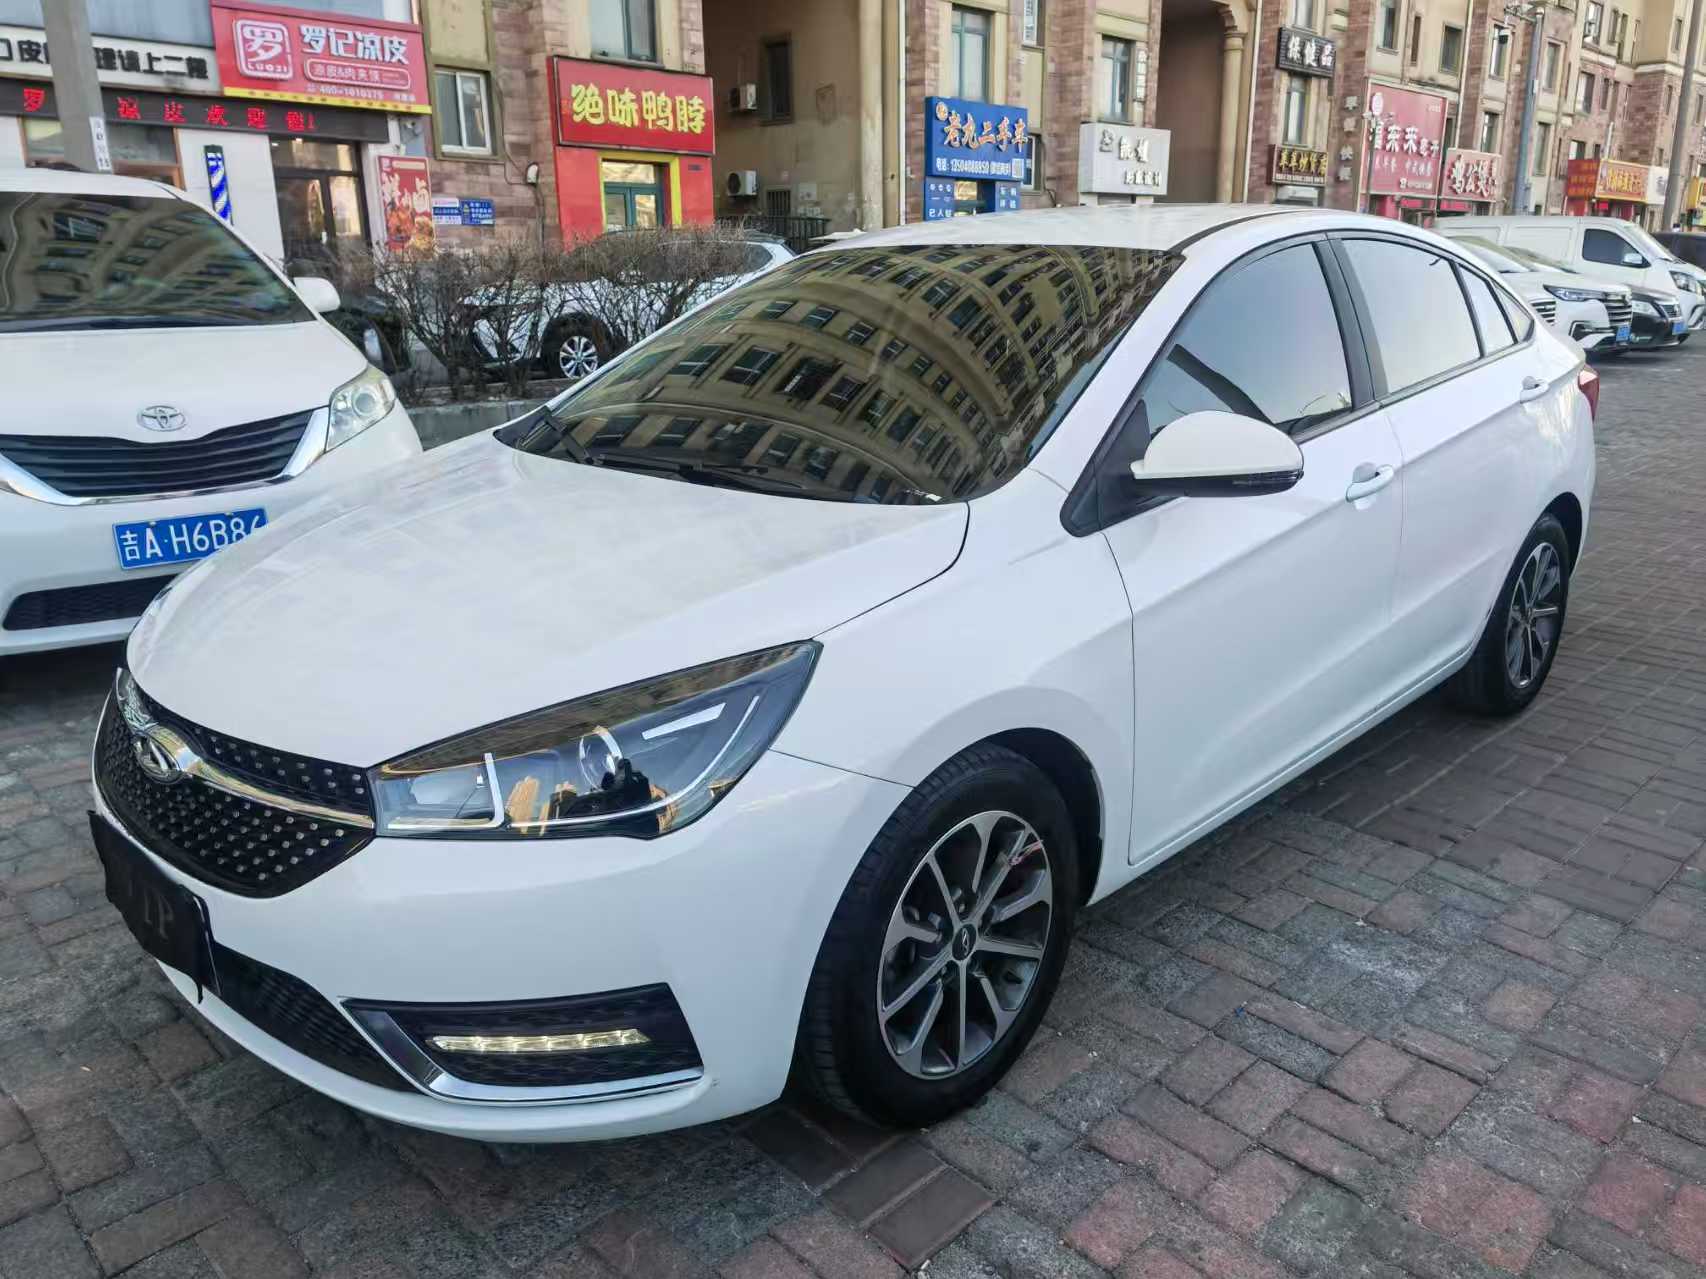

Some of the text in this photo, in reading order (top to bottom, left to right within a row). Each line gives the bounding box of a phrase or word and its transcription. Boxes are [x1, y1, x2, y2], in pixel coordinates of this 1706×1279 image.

[243, 25, 283, 62] 罗
[300, 25, 408, 64] 罗记凉皮
[571, 83, 706, 135] 绝味鸭脖
